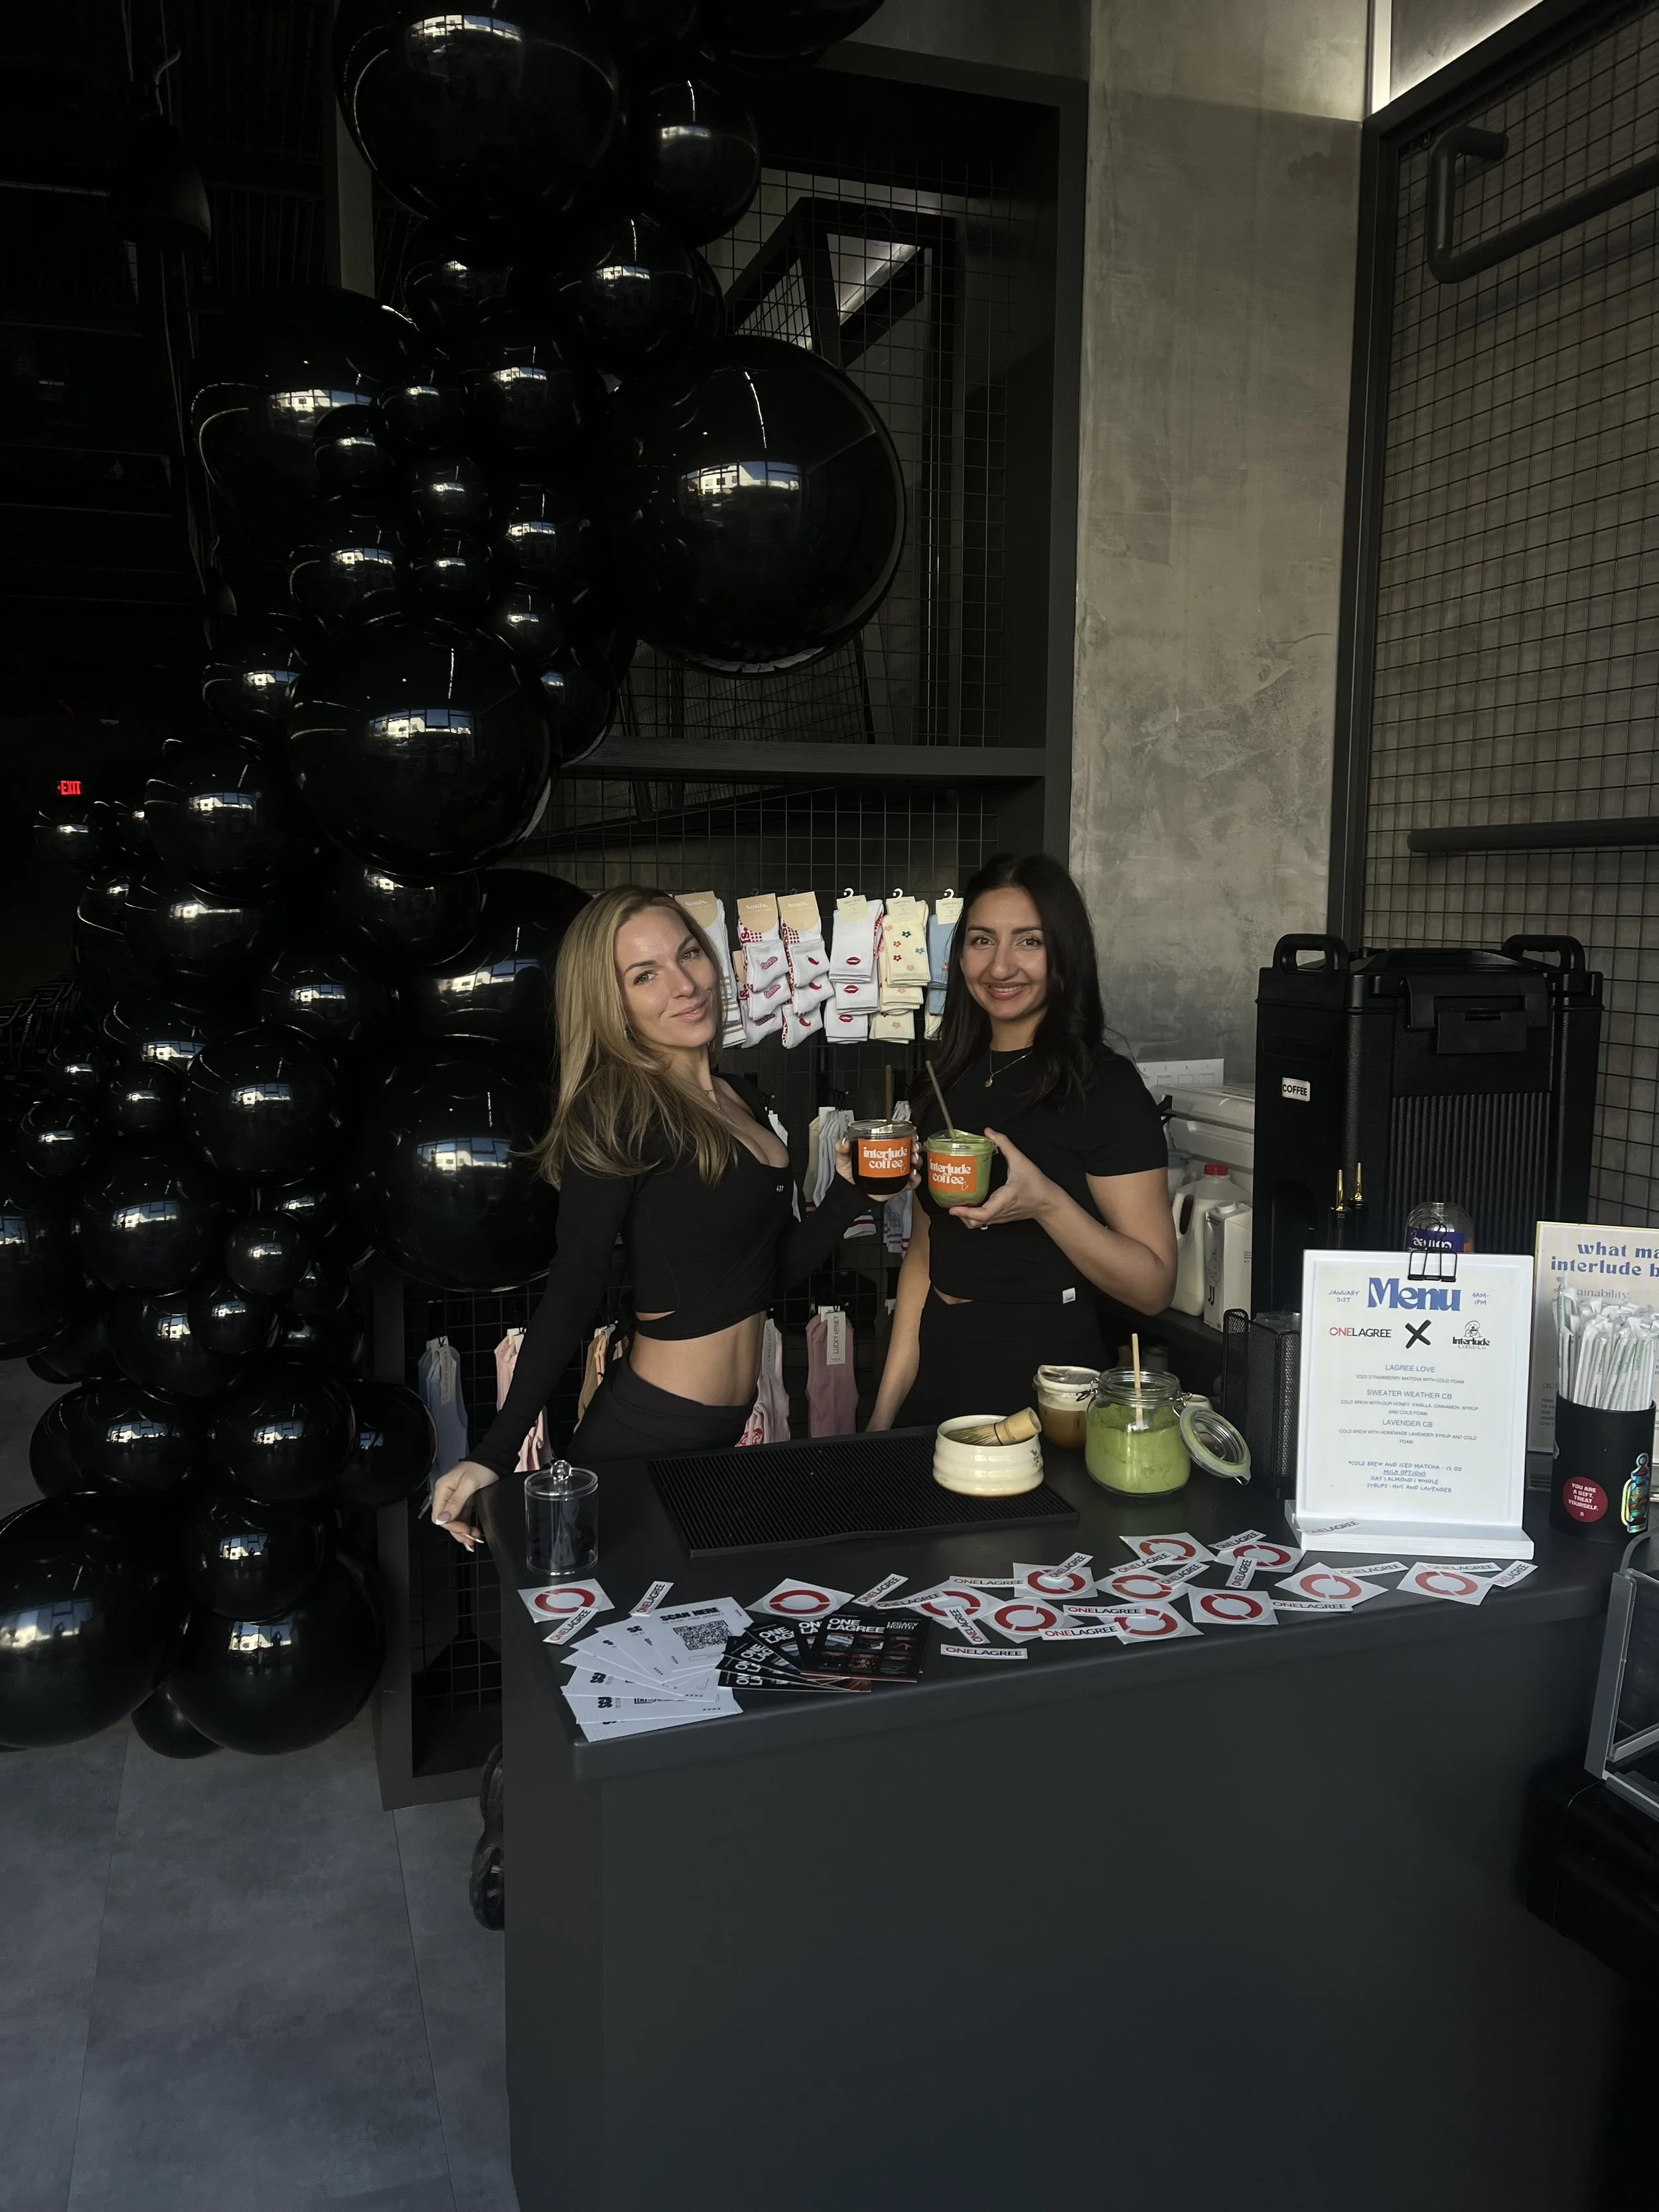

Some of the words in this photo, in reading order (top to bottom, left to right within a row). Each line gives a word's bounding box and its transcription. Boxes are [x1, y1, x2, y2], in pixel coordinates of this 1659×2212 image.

[60, 780, 81, 795] EXIT
[1283, 1084, 1307, 1096] COFFEE
[863, 1146, 908, 1160] interlude
[869, 1159, 903, 1169] coffee
[930, 1158, 972, 1175] interlude
[932, 1173, 965, 1185] coffee
[1577, 1242, 1627, 1257] what
[1551, 1256, 1642, 1276] interlude
[1367, 1277, 1462, 1311] Menu
[1329, 1327, 1392, 1338] ONELAGREE
[1453, 1337, 1490, 1346] Interlude
[1404, 1390, 1439, 1399] WEATHER
[1568, 1499, 1599, 1511] YOURSELF.
[1573, 1495, 1593, 1504] TREAT
[1216, 1532, 1259, 1549] ONELAGREE
[1118, 1552, 1171, 1574] ONELAGREE
[1340, 1564, 1402, 1575] ONELAGREE
[1495, 1564, 1529, 1585] ONELAGREE
[858, 1576, 901, 1603] ONELAGREE
[636, 1584, 666, 1613] ONELAGREE
[877, 1592, 942, 1608] ONELAGREE
[660, 1611, 691, 1621] SCAN
[691, 1607, 721, 1616] HERE
[759, 1627, 786, 1638] ONE
[827, 1624, 885, 1633] LAGREE
[950, 1608, 983, 1643] ONELAGREE
[1045, 1626, 1118, 1637] ONELAGREE
[741, 1643, 763, 1659] ONE
[946, 1647, 1022, 1657] ONELAGREE
